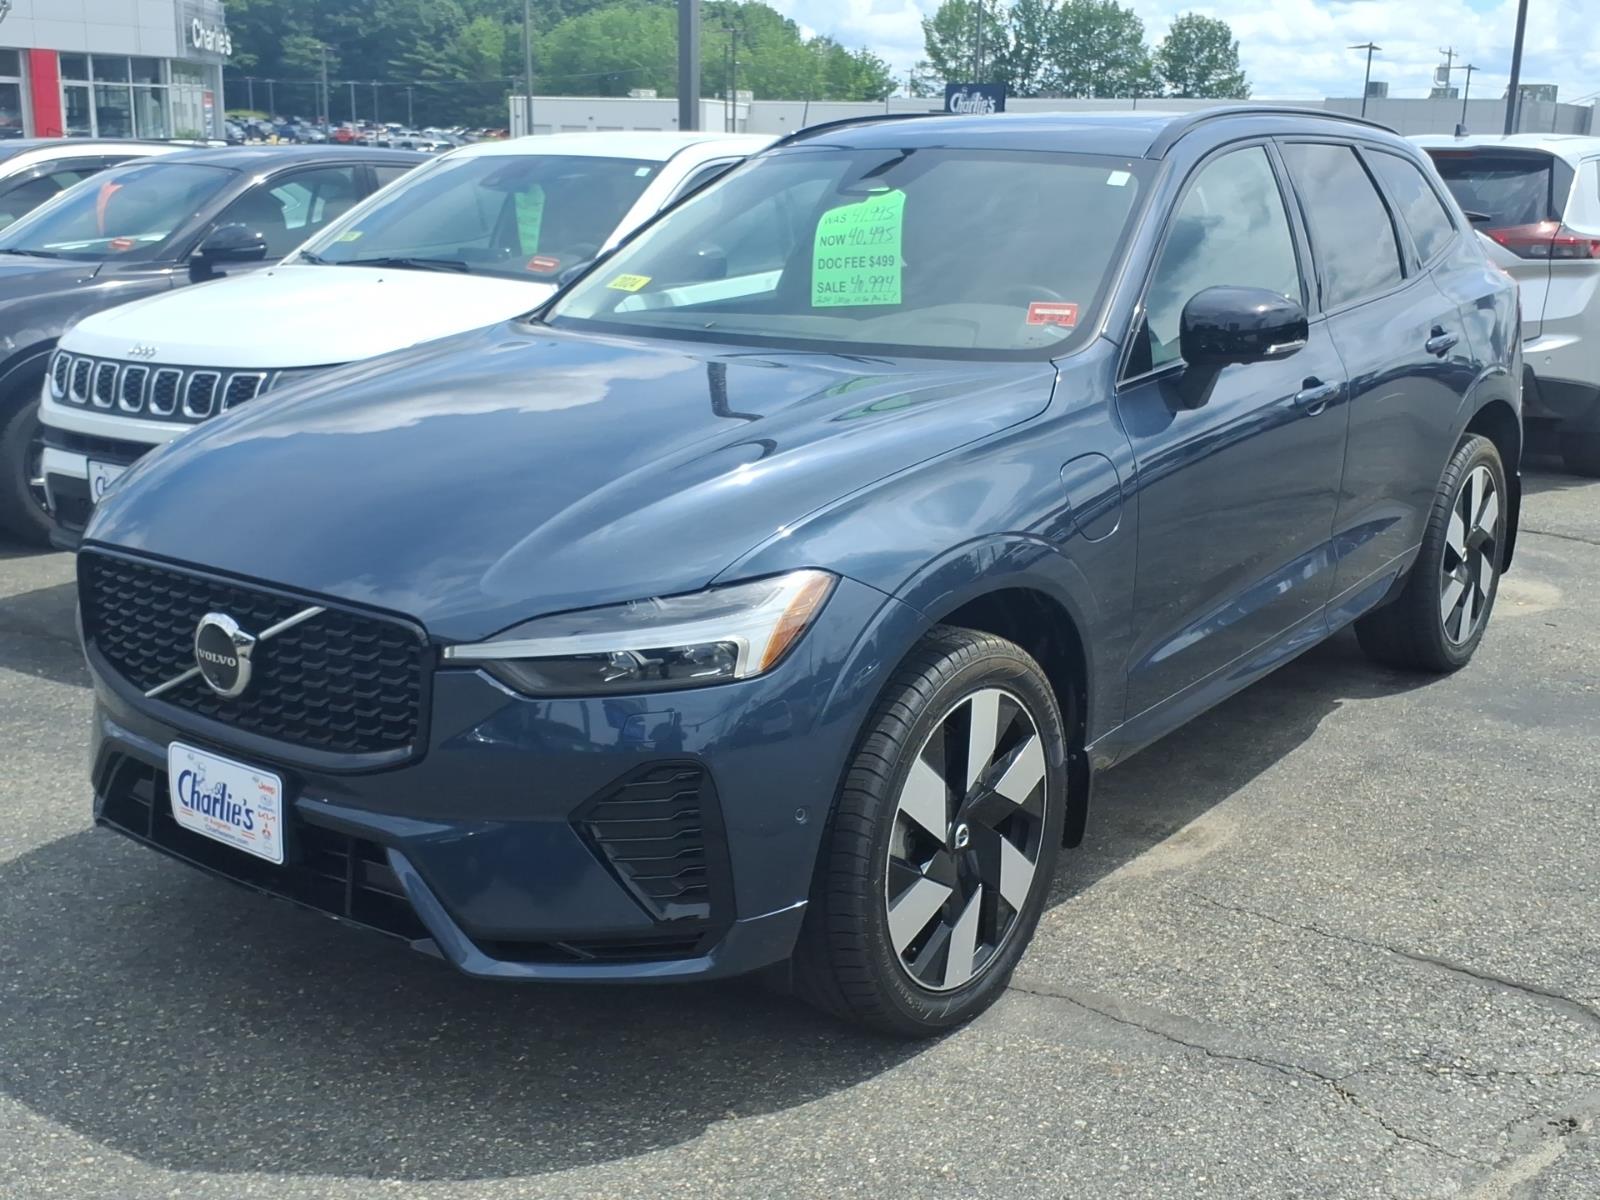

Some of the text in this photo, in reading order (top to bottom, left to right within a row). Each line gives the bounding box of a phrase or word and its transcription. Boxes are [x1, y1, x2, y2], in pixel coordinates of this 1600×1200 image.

[950, 92, 996, 114] Charlie's
[820, 234, 846, 247] NOW
[817, 255, 895, 270] DOC FEE $499
[817, 281, 847, 294] SALE
[198, 648, 237, 668] VOLVO
[177, 769, 255, 831] Charlie's
